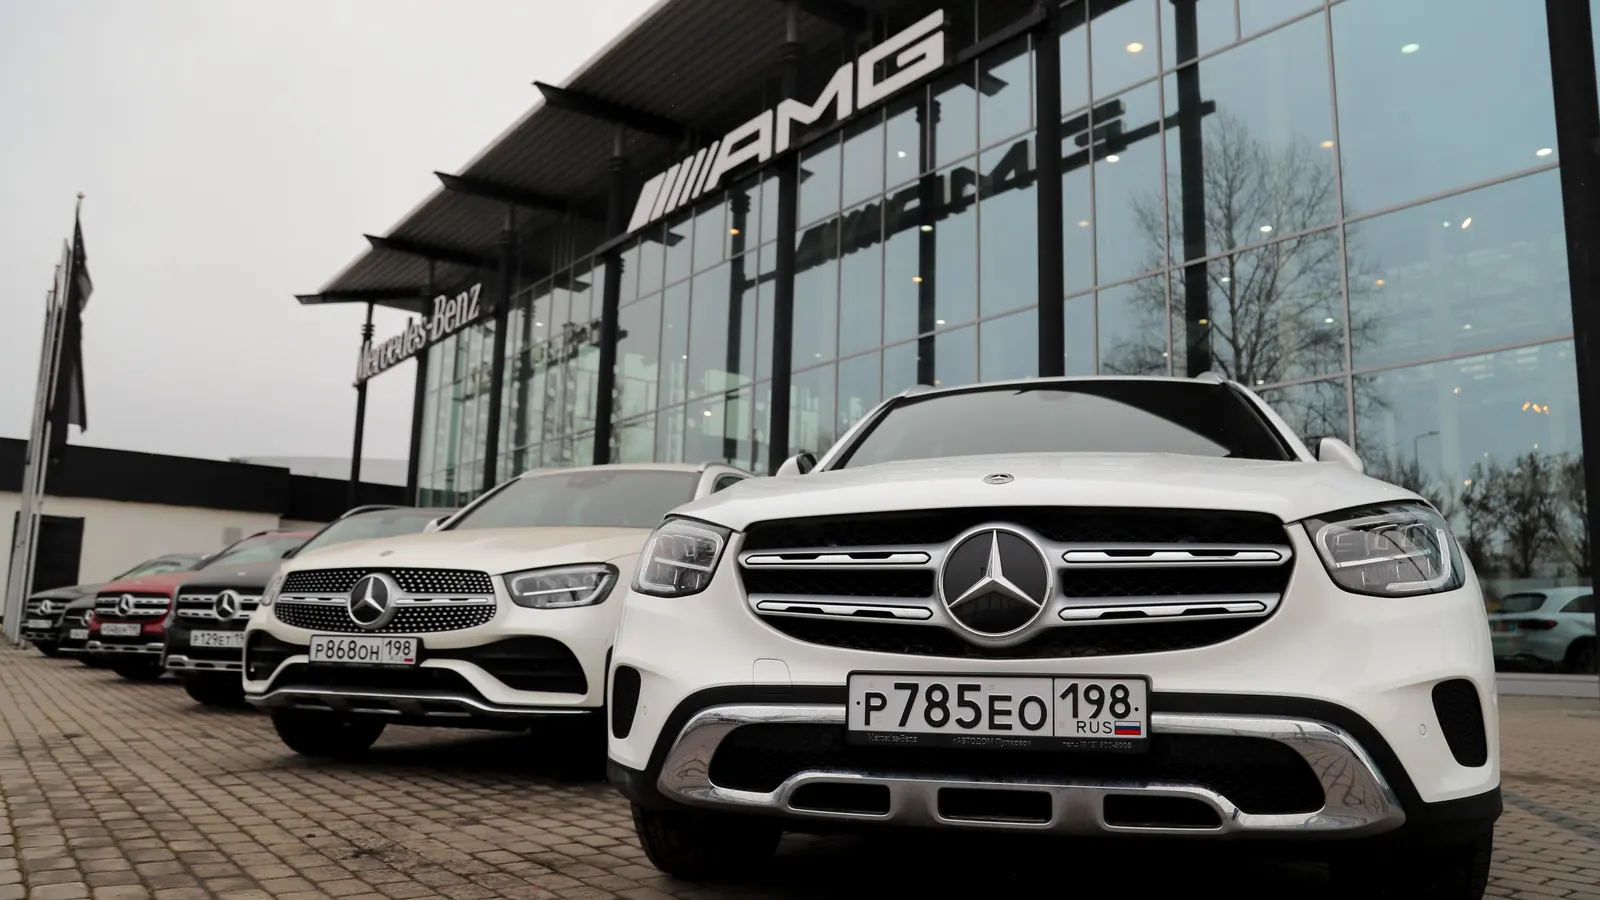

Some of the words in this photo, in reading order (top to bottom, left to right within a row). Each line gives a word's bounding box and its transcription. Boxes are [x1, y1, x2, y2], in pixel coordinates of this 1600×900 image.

[702, 8, 944, 194] AMG
[384, 639, 411, 656] 198
[1059, 682, 1132, 720] 198
[1076, 720, 1113, 734] RUS
